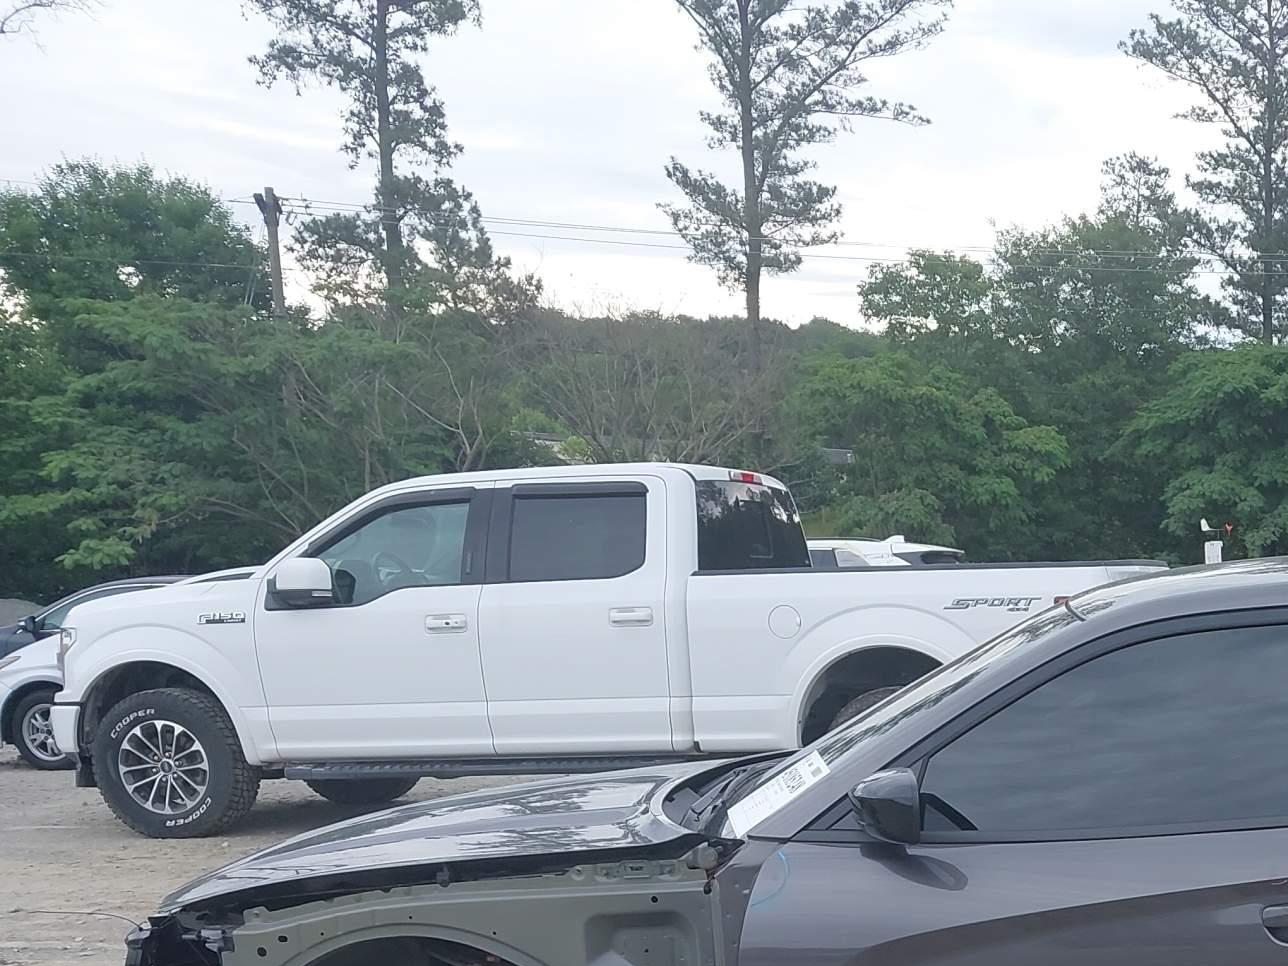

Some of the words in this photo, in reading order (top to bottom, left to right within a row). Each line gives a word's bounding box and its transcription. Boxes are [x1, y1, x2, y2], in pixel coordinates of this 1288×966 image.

[943, 596, 1042, 610] SPORT
[110, 707, 156, 739] COOPER
[165, 796, 212, 828] COOPER
